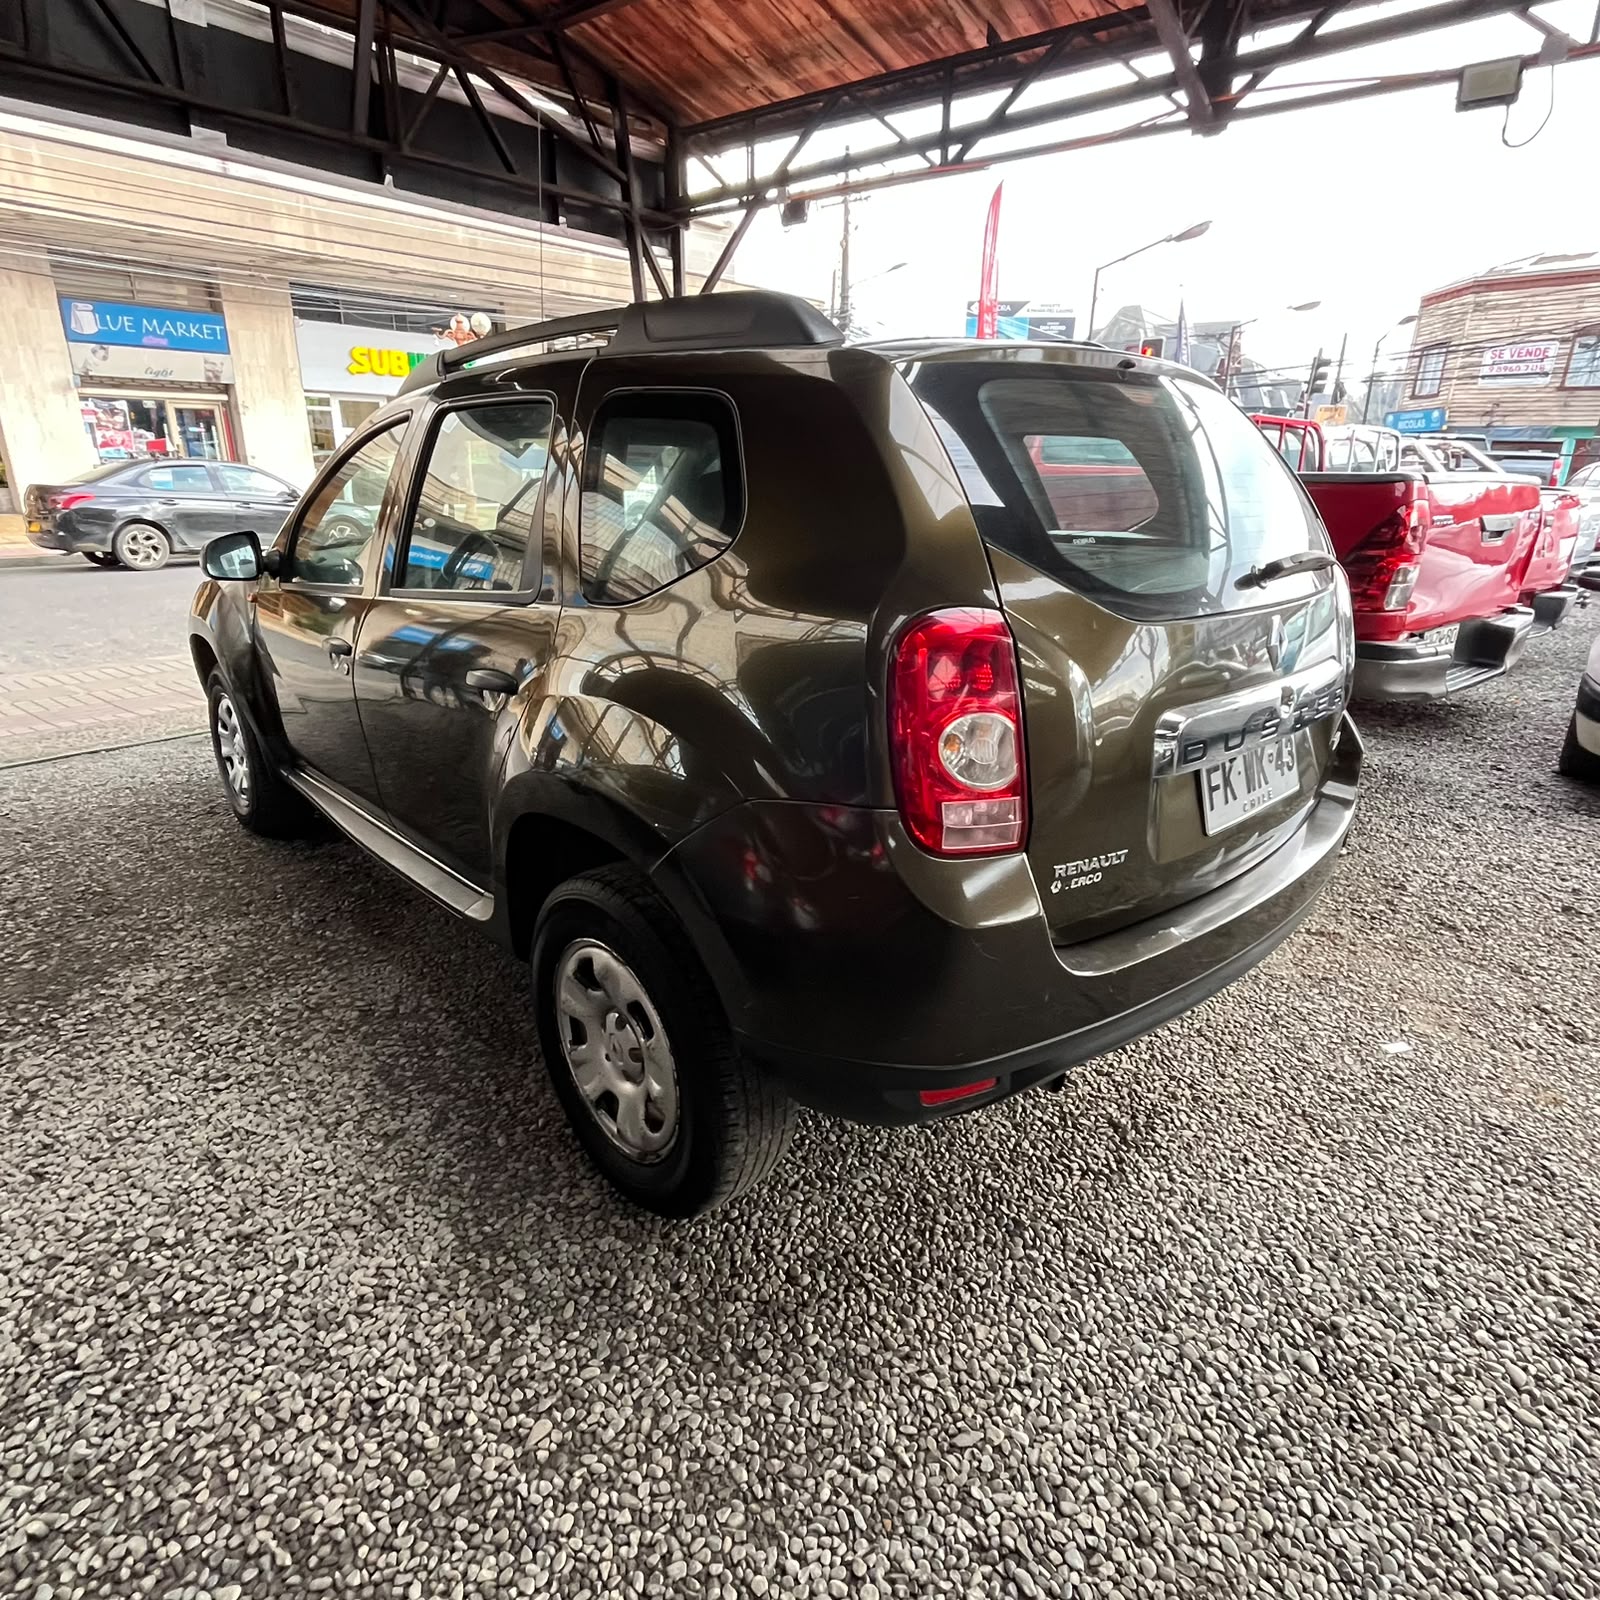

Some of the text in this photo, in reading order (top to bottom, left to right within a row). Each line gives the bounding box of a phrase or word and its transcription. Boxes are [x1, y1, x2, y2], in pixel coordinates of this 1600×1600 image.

[142, 317, 226, 341] MARKET
[348, 346, 432, 377] SUB
[1490, 346, 1551, 360] SE VENDE
[1181, 685, 1344, 769] DUSTER
[1242, 787, 1274, 813] CHILE
[1053, 848, 1129, 879] RENAULT
